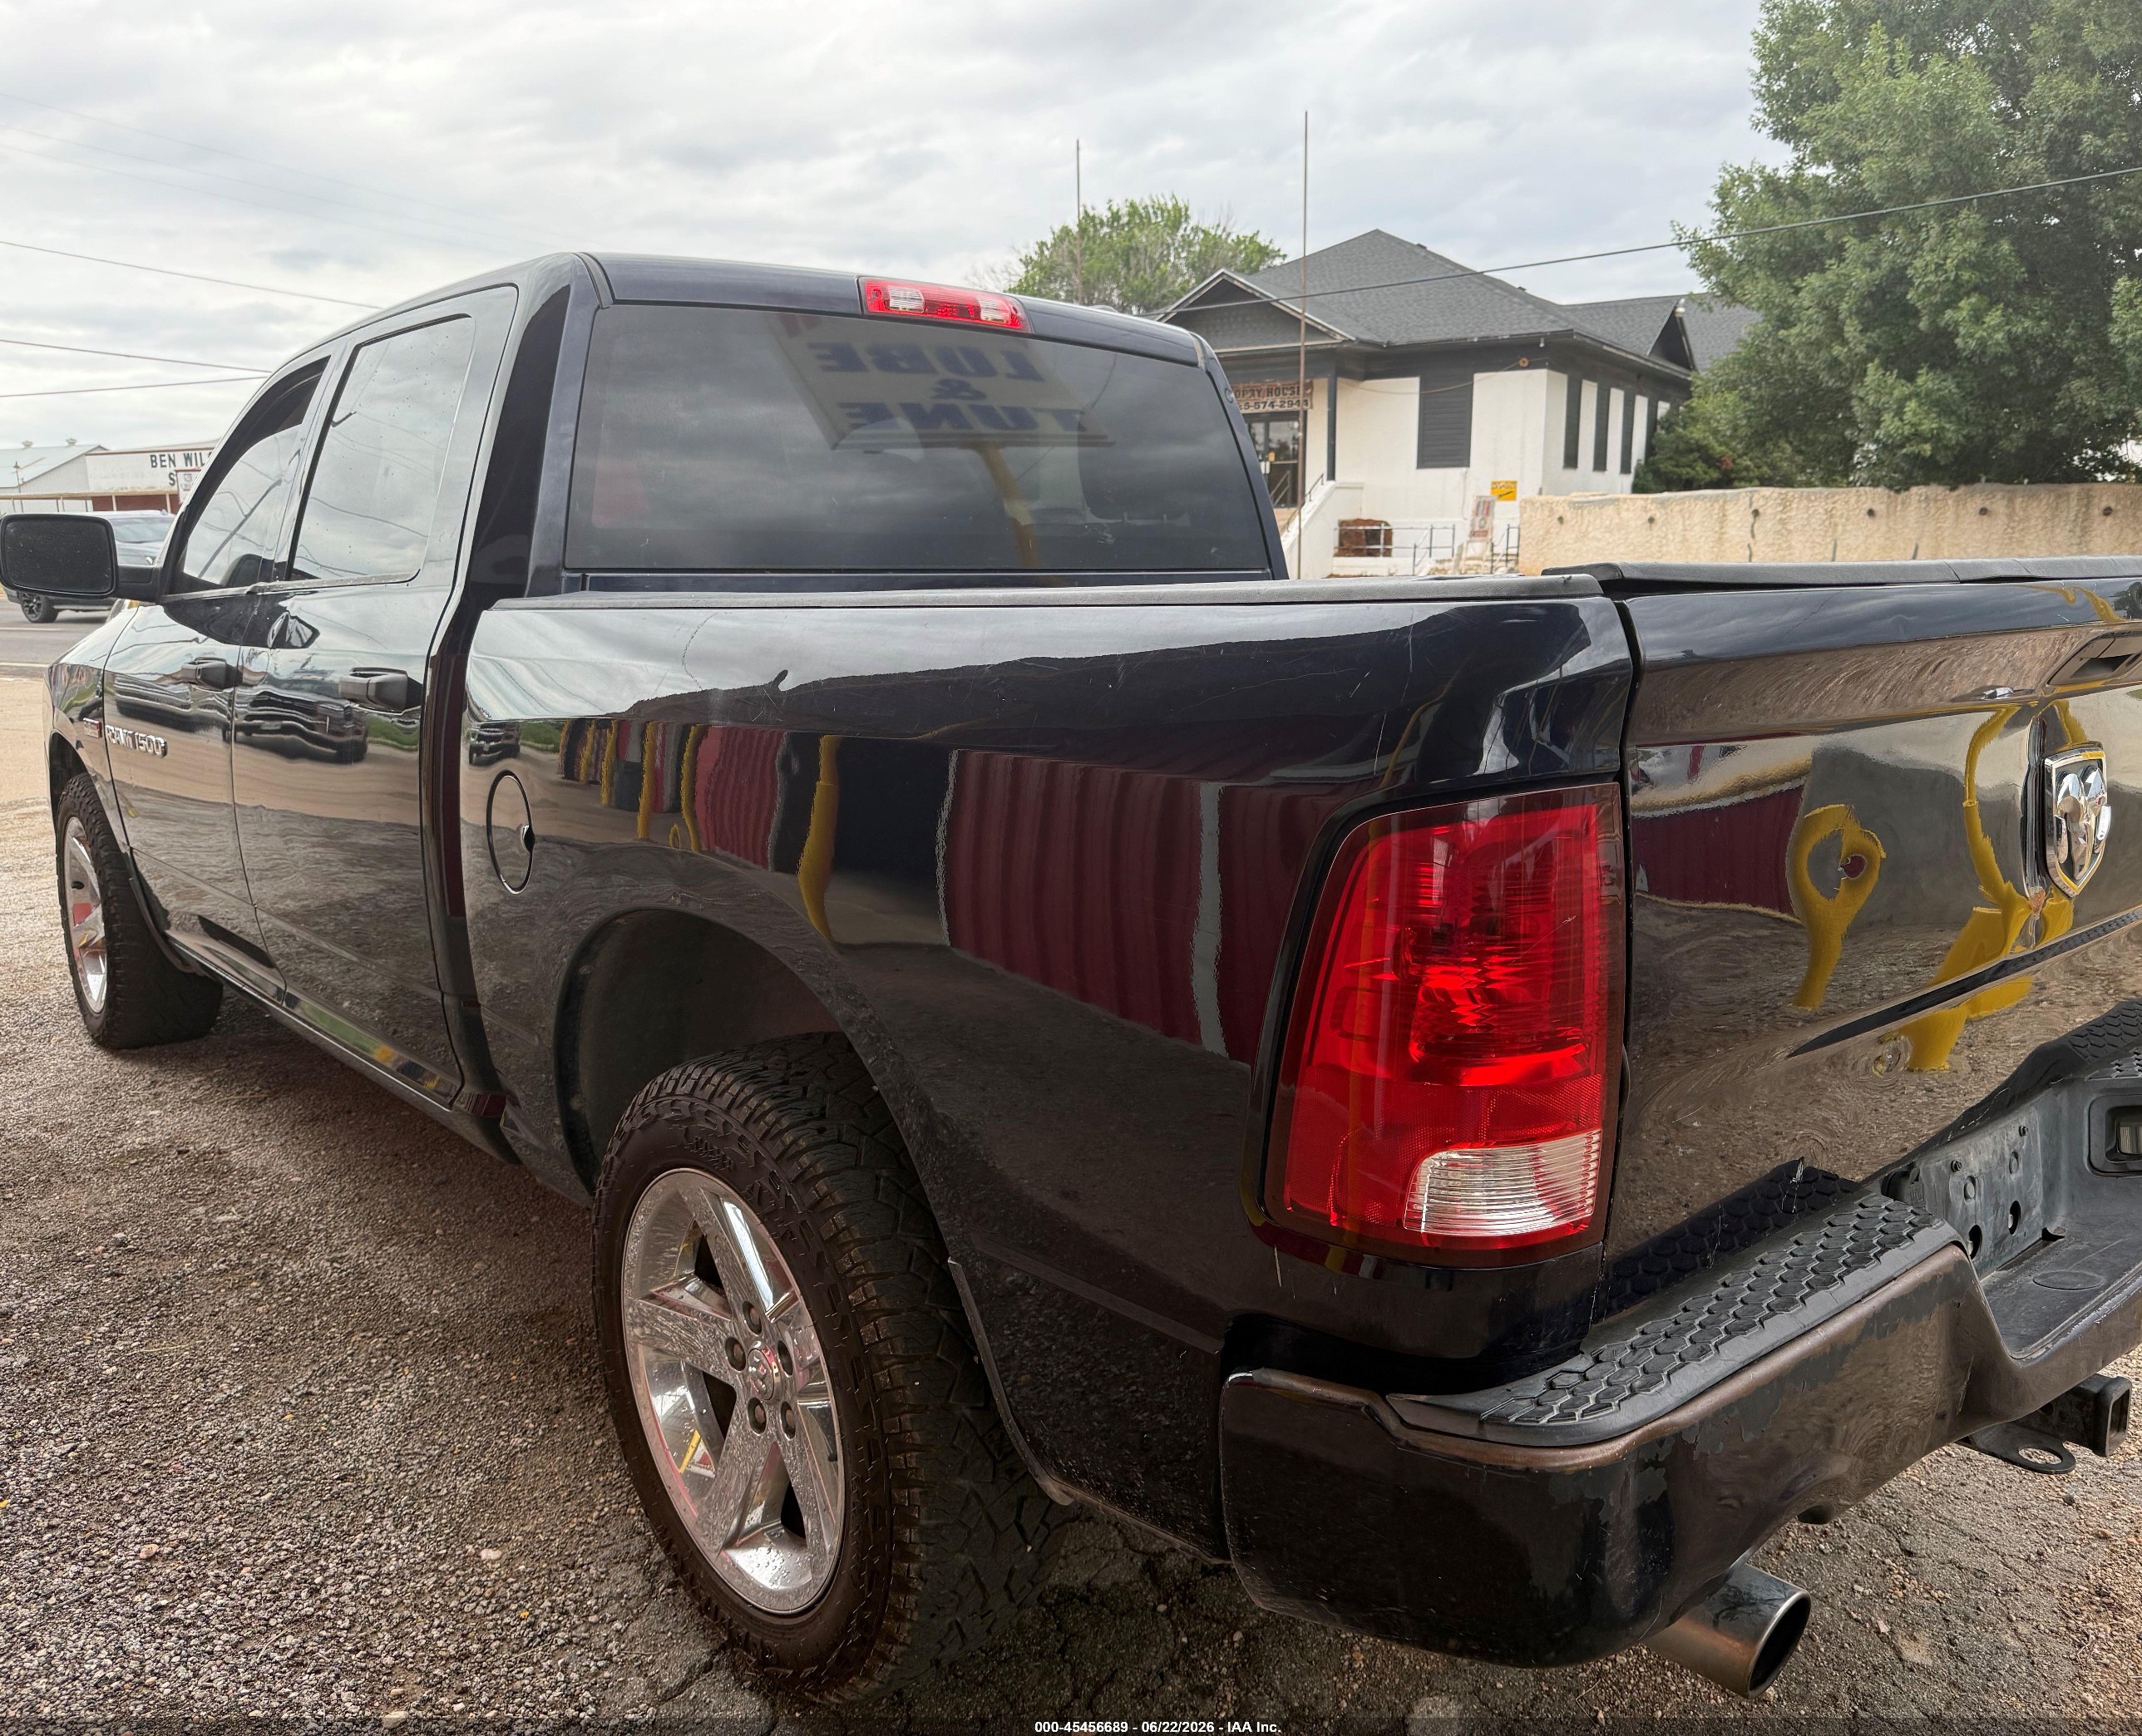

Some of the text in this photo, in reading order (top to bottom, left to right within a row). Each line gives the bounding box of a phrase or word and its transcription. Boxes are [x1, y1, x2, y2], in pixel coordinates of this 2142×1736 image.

[150, 453, 176, 468] BEN
[168, 471, 176, 486] S
[134, 732, 167, 758] 1500
